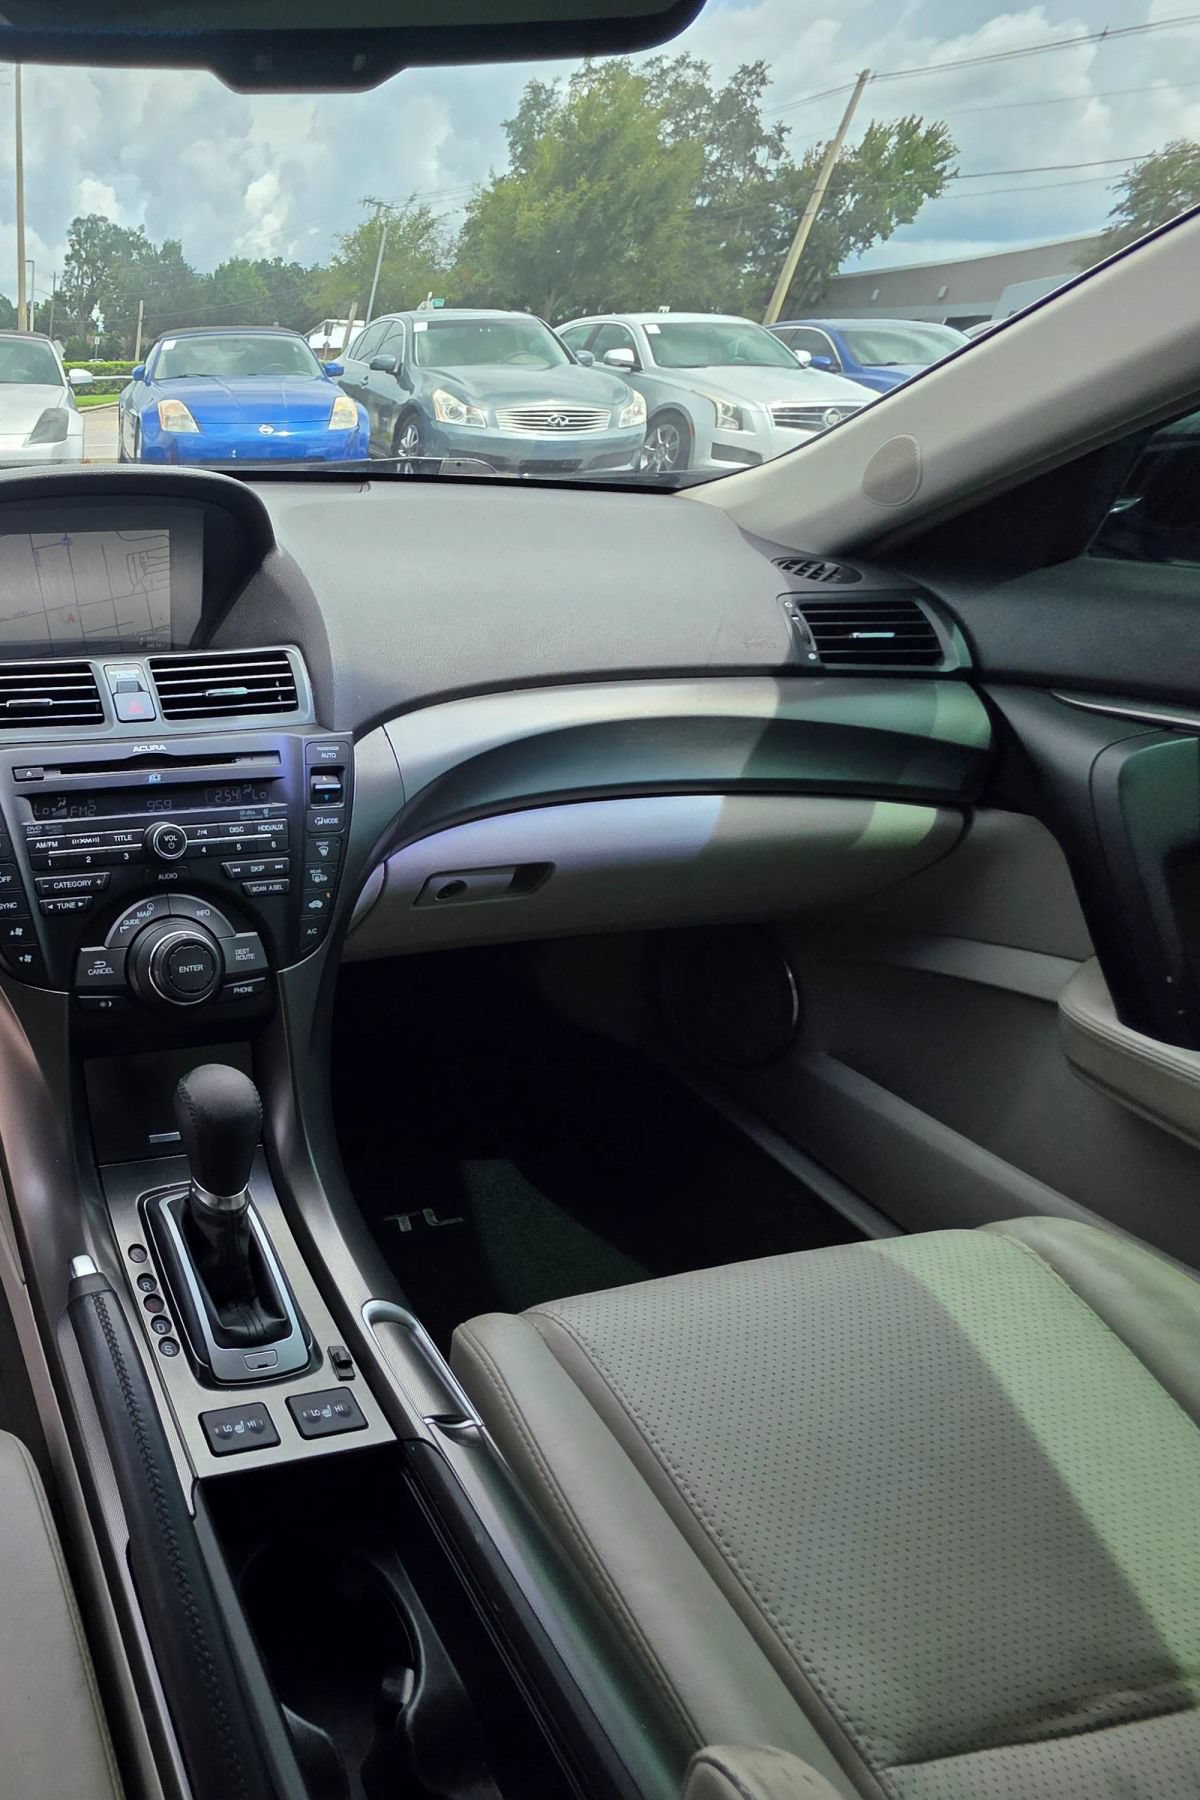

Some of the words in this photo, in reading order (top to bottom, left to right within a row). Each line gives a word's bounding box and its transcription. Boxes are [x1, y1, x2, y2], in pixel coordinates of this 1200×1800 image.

[133, 744, 167, 752] ACURA
[70, 804, 96, 817] FM2
[257, 824, 284, 832] HDD/AUX
[113, 834, 133, 842] TITLE
[163, 834, 178, 842] VOL
[35, 841, 59, 849] AM/FM
[236, 843, 242, 851] 5
[271, 840, 277, 848] 6
[86, 855, 92, 863] 2
[123, 852, 129, 860] 3
[53, 879, 92, 889] CATEGORY
[56, 901, 77, 910] TUNE
[196, 908, 211, 917] INFO
[87, 967, 115, 975] CANCEL
[178, 964, 204, 973] ENTER
[233, 985, 254, 994] PHONE
[383, 1208, 464, 1232] TL
[143, 1281, 151, 1290] R
[157, 1323, 165, 1332] D
[165, 1345, 173, 1354] S
[310, 1408, 320, 1417] LO
[334, 1403, 344, 1412] HI
[222, 1424, 233, 1433] LO
[247, 1419, 257, 1429] HI
